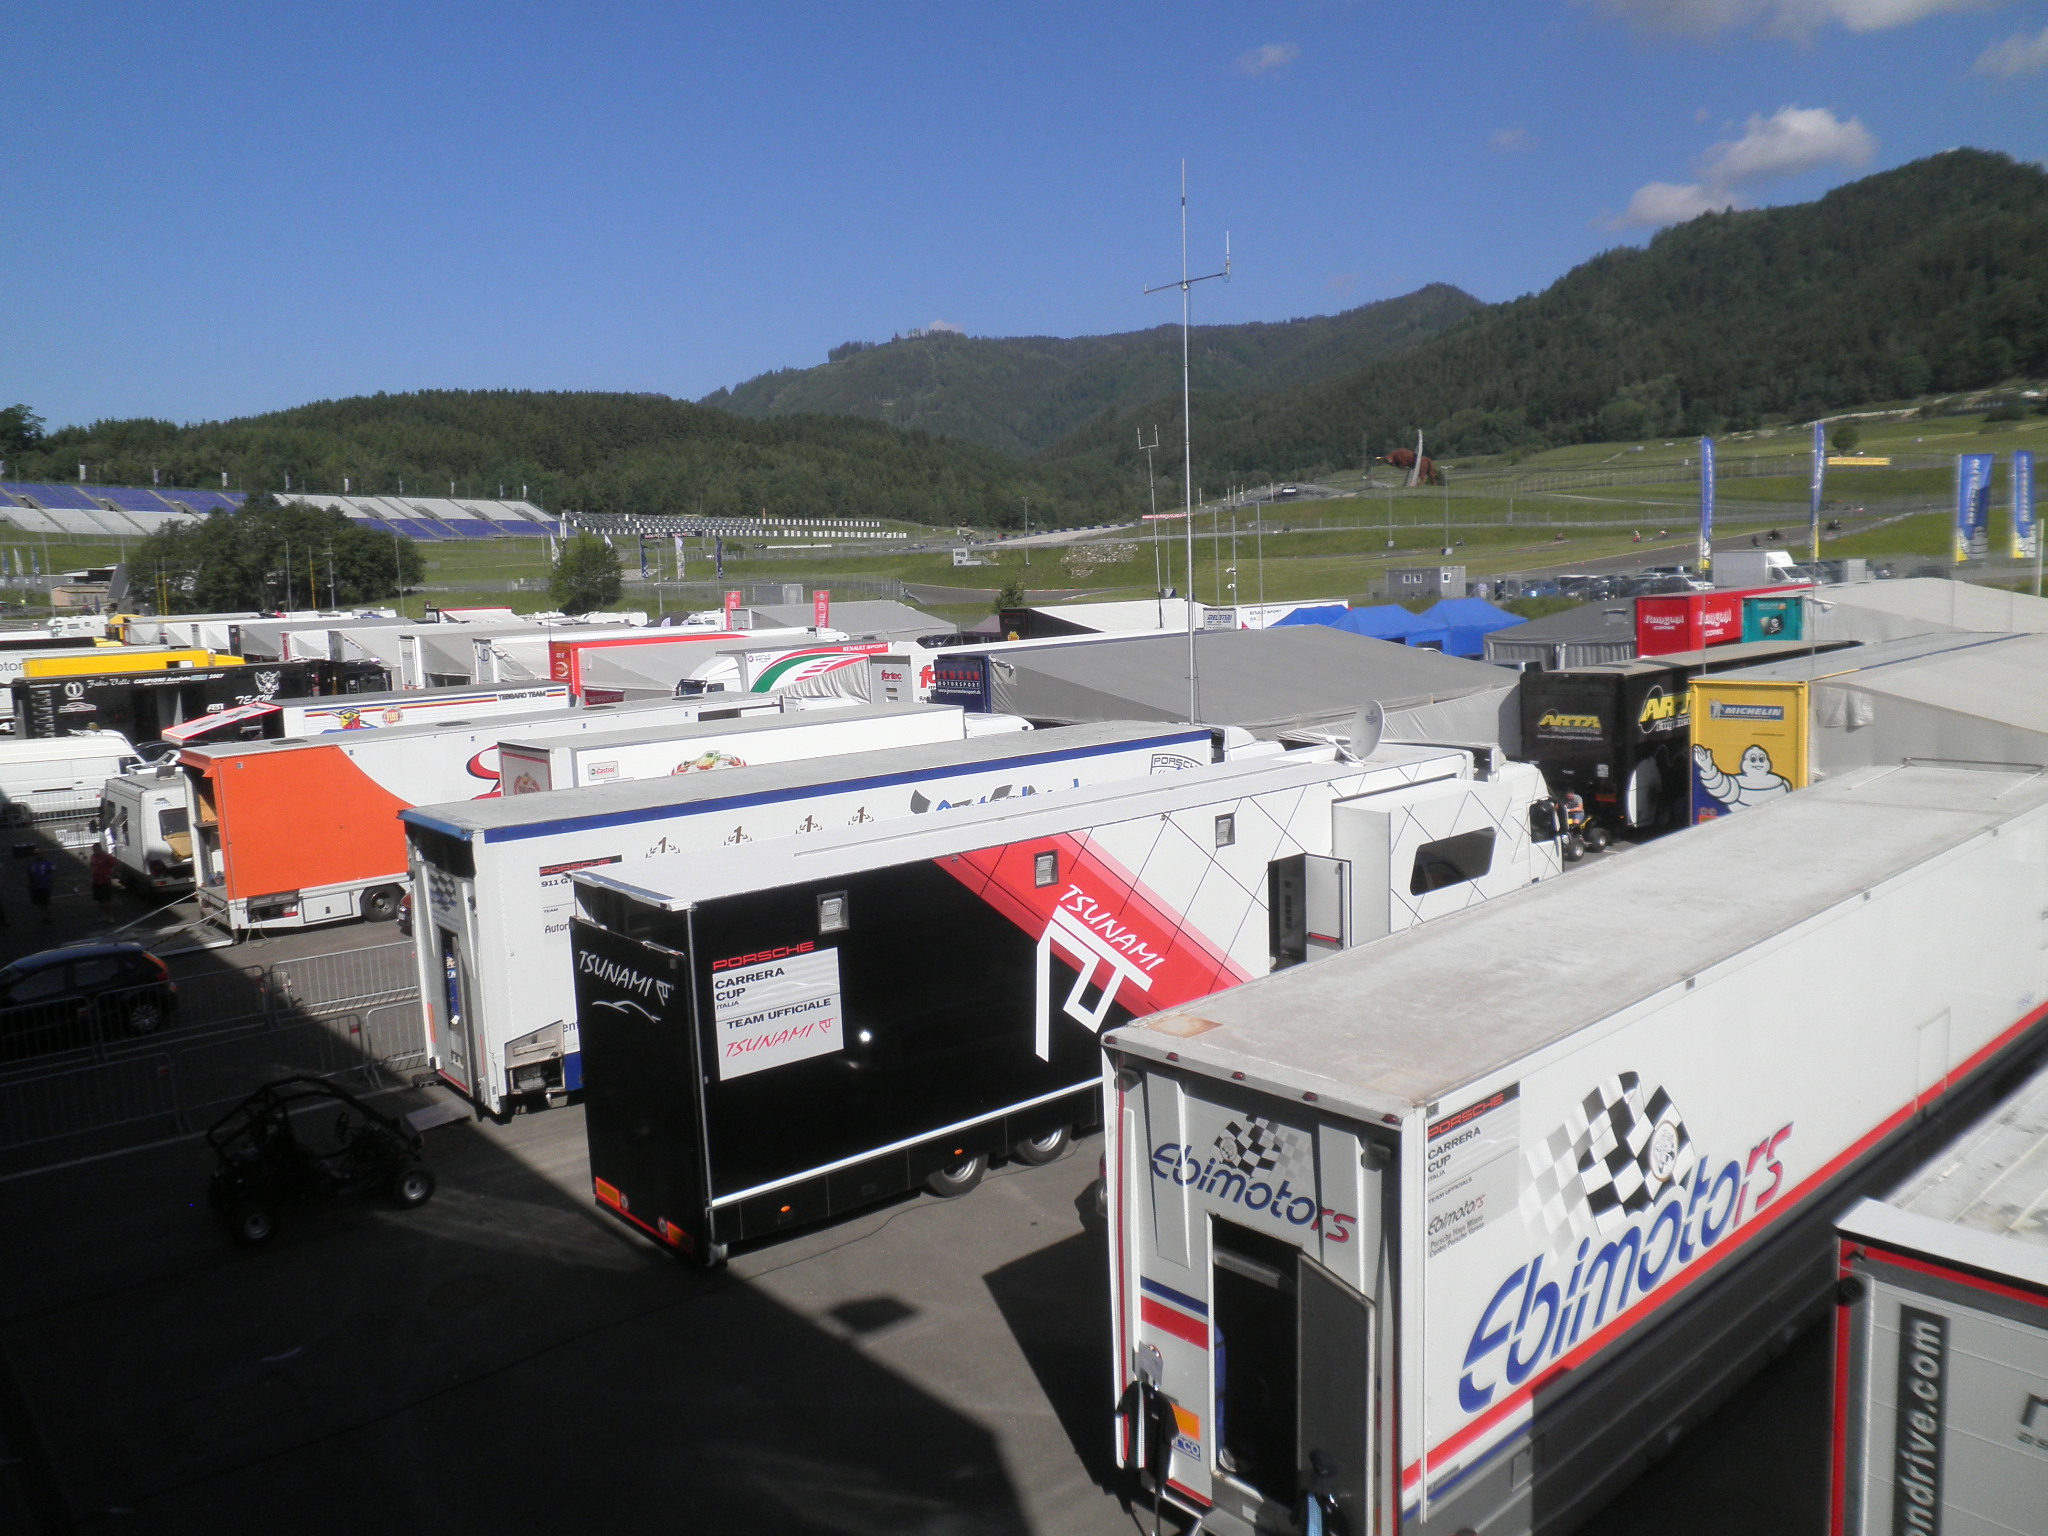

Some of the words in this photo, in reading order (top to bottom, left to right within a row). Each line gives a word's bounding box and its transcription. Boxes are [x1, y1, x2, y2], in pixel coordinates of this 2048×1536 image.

[881, 670, 902, 680] fortec
[386, 712, 400, 723] FIAT
[1724, 707, 1782, 716] MICHELIN
[1539, 714, 1602, 728] ARTA
[804, 815, 813, 832] 1
[858, 806, 866, 823] 1
[734, 826, 742, 843] 1
[658, 837, 668, 854] 1
[540, 859, 611, 874] PORSCHE
[541, 880, 559, 888] 911
[1060, 884, 1164, 970] TSUNAMI
[712, 941, 814, 971] PORSCHE
[579, 950, 653, 996] TSUNAMI
[715, 967, 785, 990] CARRERA
[715, 988, 746, 1001] CUP
[716, 1000, 739, 1010] ITALIA
[727, 1013, 765, 1029] TEAM
[768, 998, 831, 1020] UFFICIALE
[725, 1023, 814, 1058] TSUNAMI
[1428, 1093, 1504, 1140] PORSCHE
[1428, 1126, 1481, 1160] CARRERA
[1428, 1154, 1451, 1173] CUP
[1428, 1170, 1446, 1182] ITALIA
[1152, 1142, 1357, 1243] Ebimotors
[1428, 1192, 1444, 1204] TEAM
[1445, 1176, 1472, 1195] UFFICIALE
[1428, 1194, 1486, 1236] Ebimotors
[1458, 1121, 1794, 1414] Ebimotors
